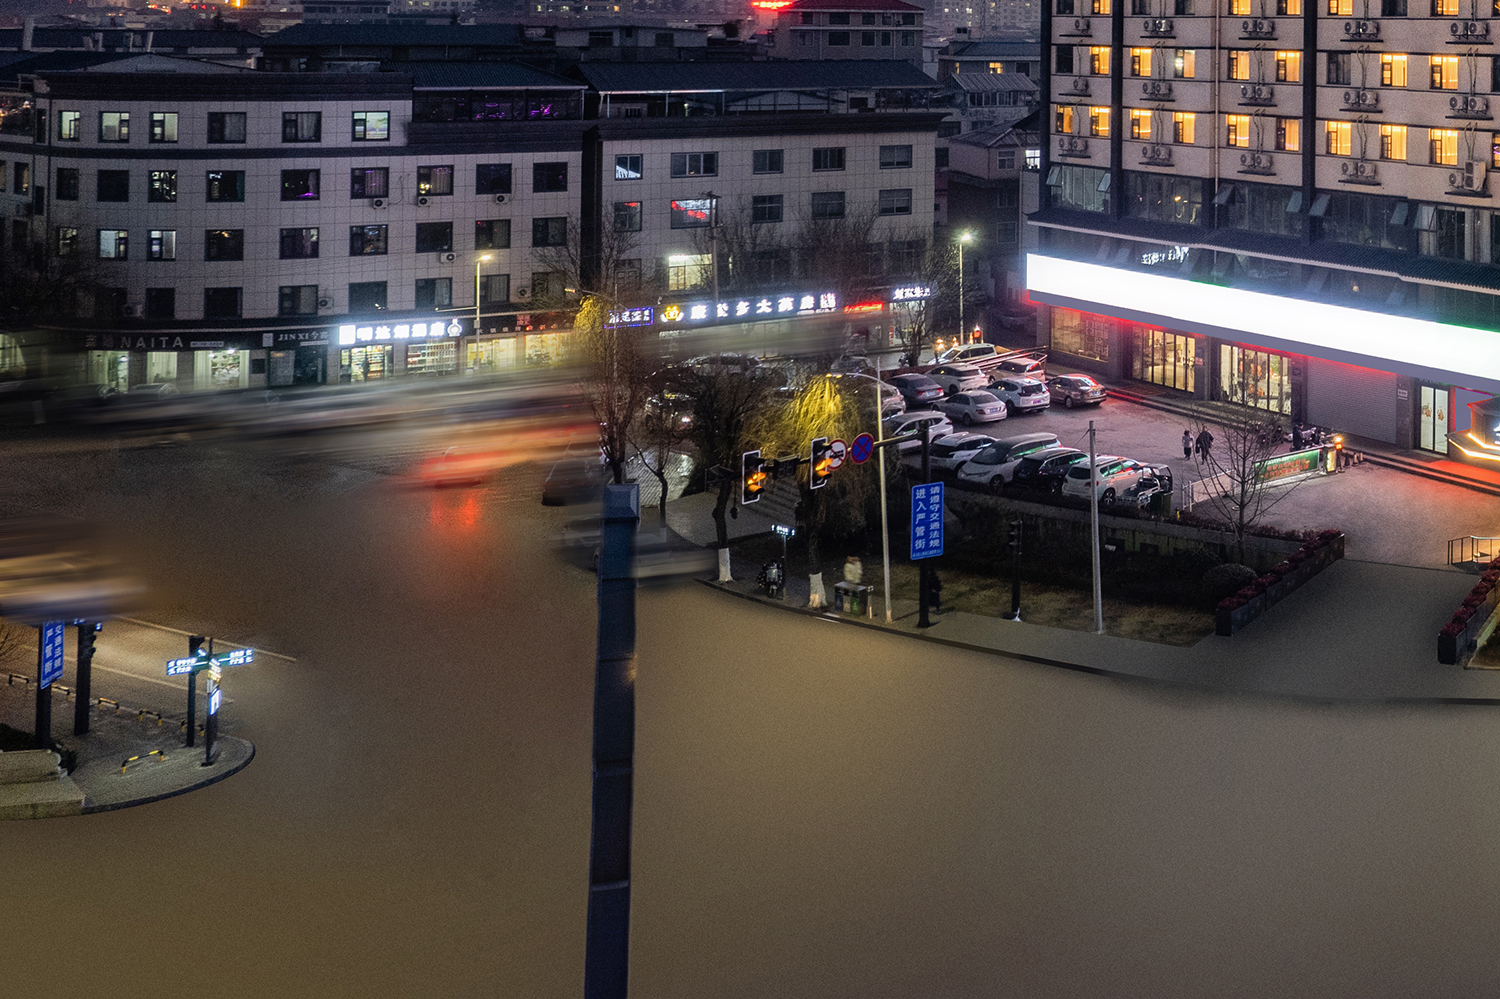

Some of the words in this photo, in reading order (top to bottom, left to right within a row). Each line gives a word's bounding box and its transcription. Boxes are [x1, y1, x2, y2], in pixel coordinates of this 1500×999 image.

[121, 336, 184, 348] NAITA
[914, 488, 927, 550] 进入严管街
[929, 486, 941, 548] 请遵守交通法规
